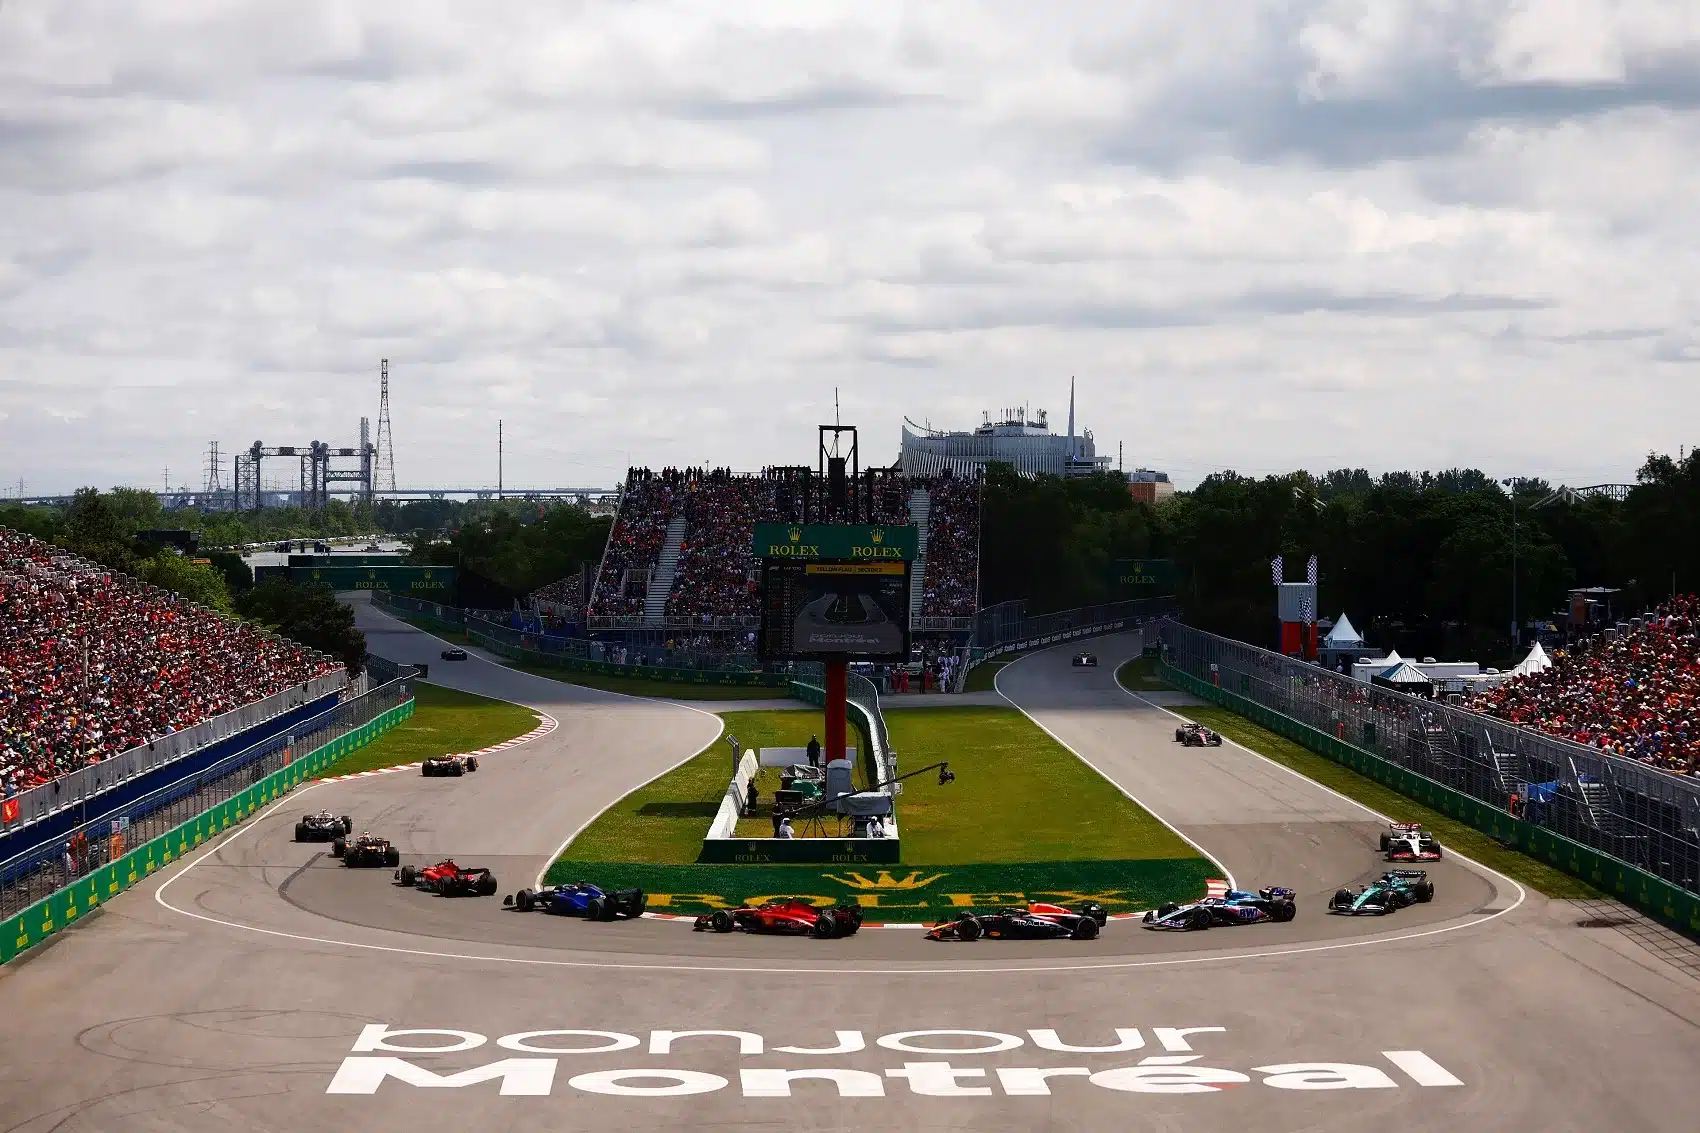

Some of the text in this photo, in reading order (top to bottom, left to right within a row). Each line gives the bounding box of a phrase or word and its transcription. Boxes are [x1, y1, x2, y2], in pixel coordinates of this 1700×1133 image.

[769, 545, 820, 556] ROLEX
[851, 546, 902, 557] ROLEX
[1120, 576, 1156, 584] ROLEX
[355, 581, 389, 589] ROLEX
[411, 581, 445, 589] ROLEX
[735, 854, 771, 862] ROLEX
[832, 854, 868, 862] ROLEX
[1012, 919, 1051, 927] ORACLE
[351, 1023, 1226, 1054] bonjour
[326, 1051, 1464, 1097] Montréal
